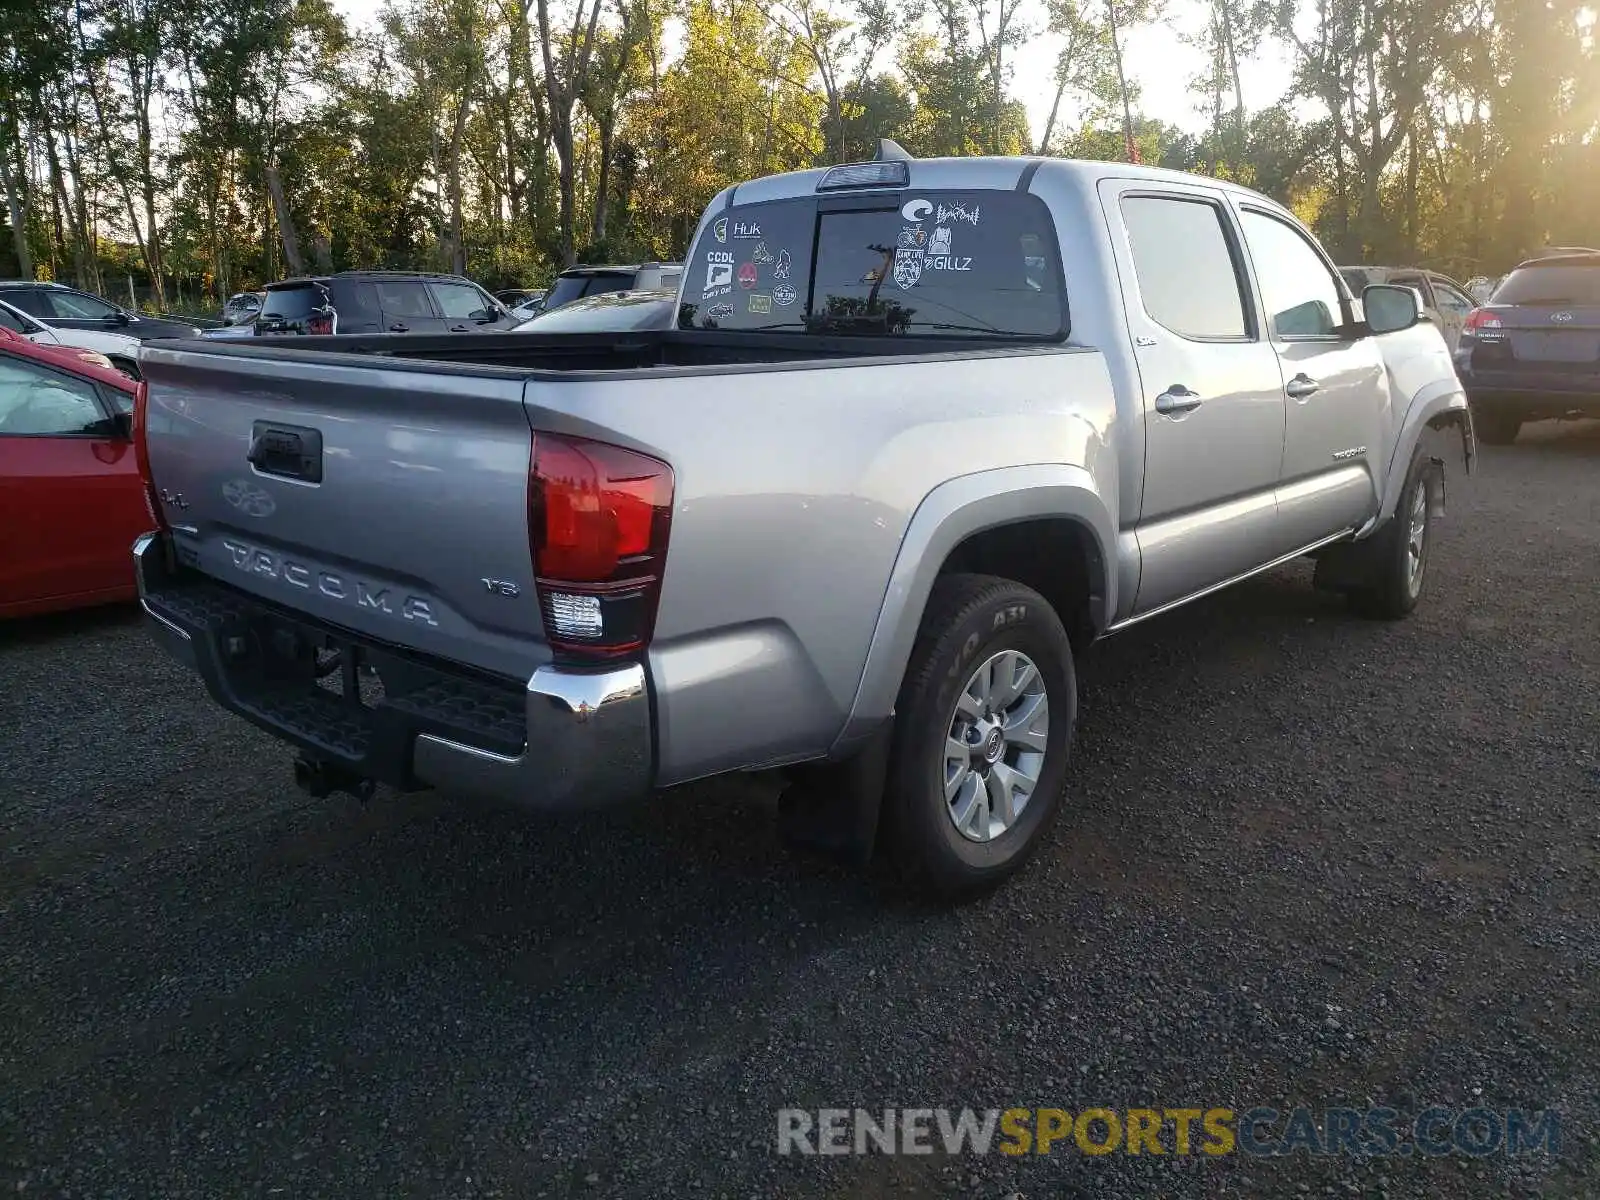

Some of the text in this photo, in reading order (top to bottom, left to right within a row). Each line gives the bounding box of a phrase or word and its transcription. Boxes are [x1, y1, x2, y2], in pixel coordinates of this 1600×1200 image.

[707, 252, 735, 264] CCDL
[934, 256, 972, 271] GILLZ
[222, 540, 439, 627] TACOMA
[481, 576, 520, 597] V6
